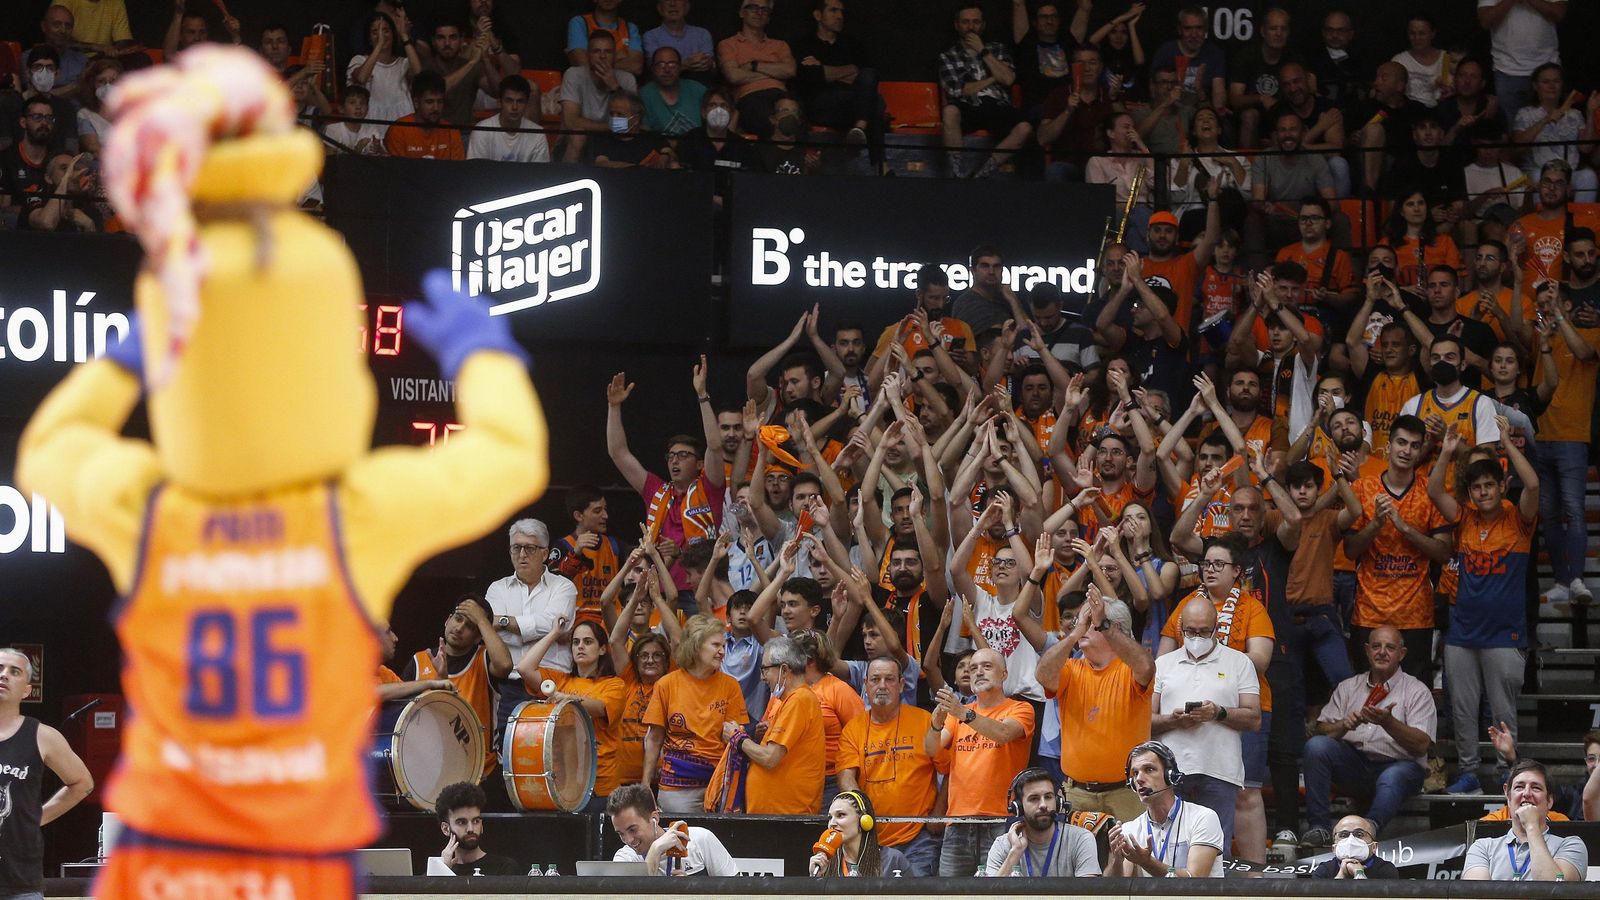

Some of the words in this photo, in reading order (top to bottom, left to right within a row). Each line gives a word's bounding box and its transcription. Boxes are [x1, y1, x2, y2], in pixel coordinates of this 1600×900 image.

[474, 203, 583, 256] Oscar
[803, 252, 867, 288] the
[872, 257, 974, 290] trae
[1001, 259, 1096, 293] rand
[738, 563, 752, 586] 12
[186, 609, 306, 718] 86
[0, 763, 29, 780] ead
